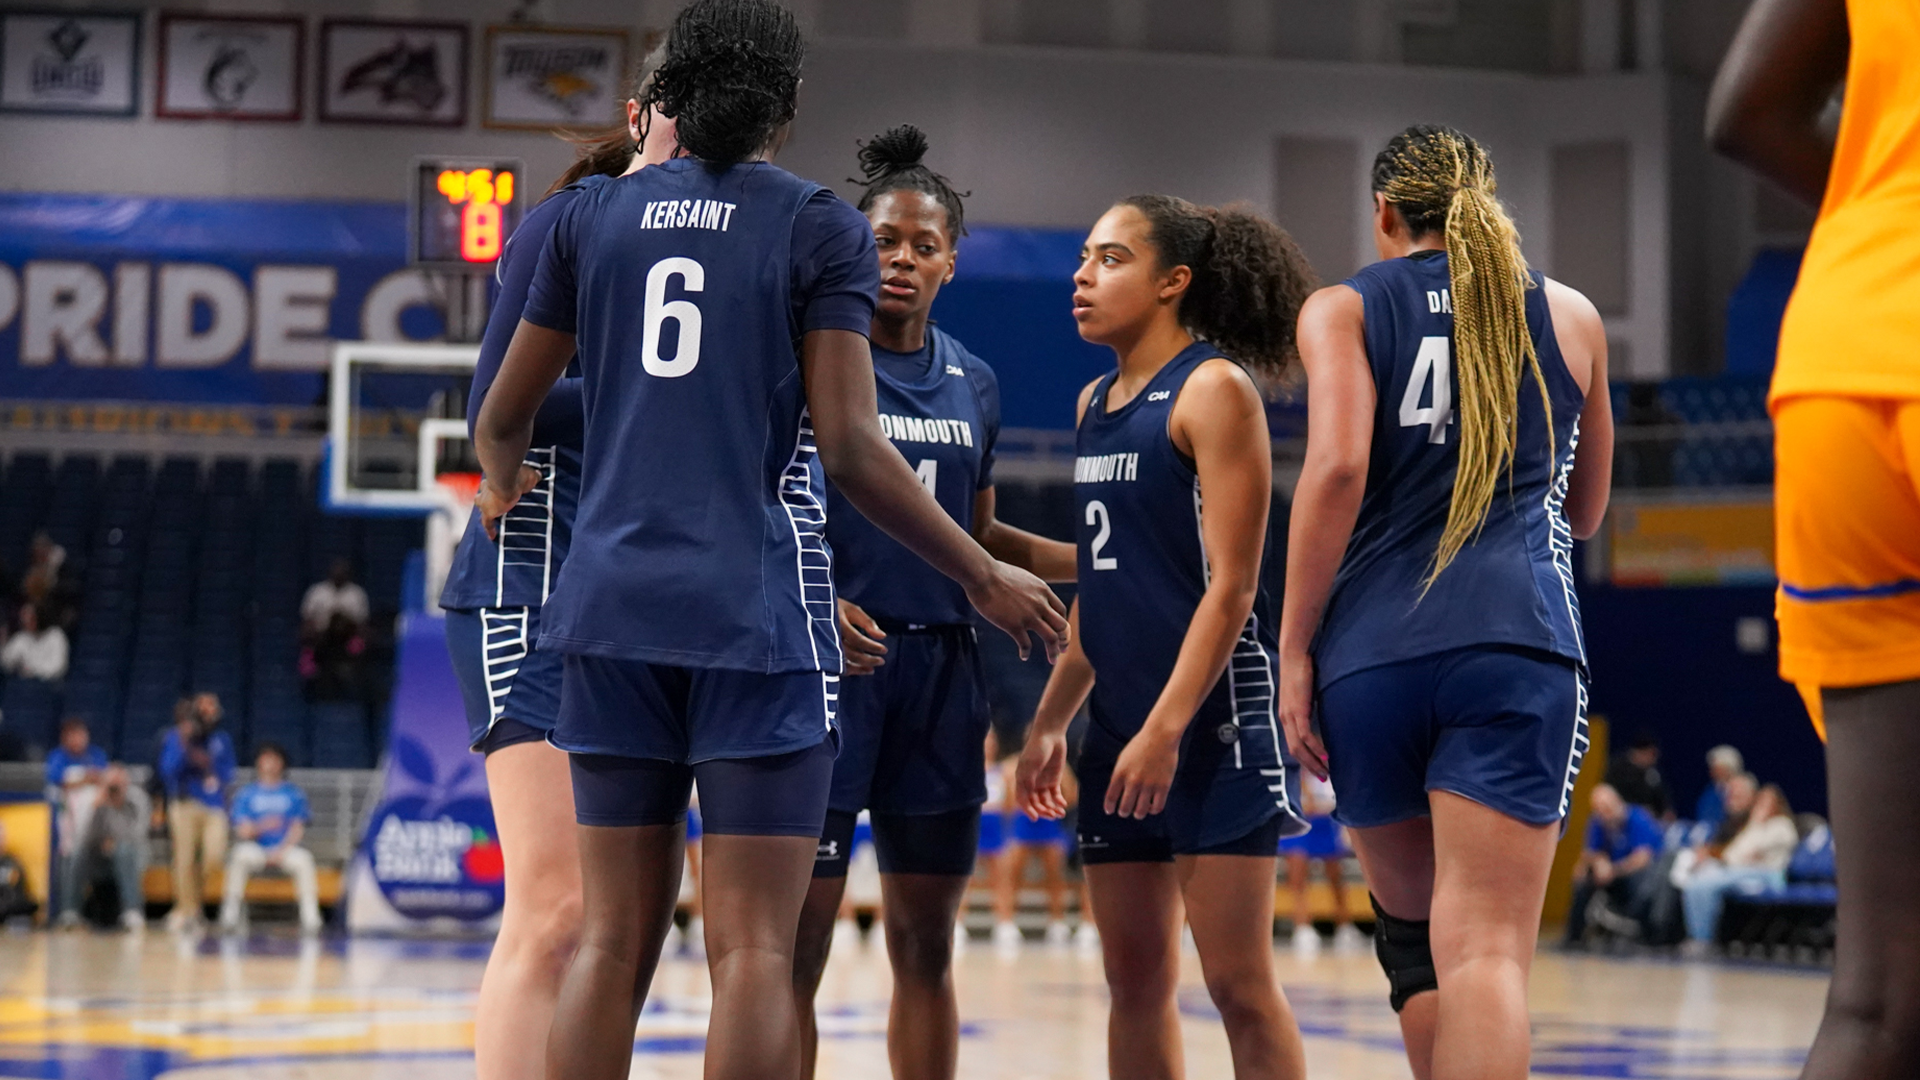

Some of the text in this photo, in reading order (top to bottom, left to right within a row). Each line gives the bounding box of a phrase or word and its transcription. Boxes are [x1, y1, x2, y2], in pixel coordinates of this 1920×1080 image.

[640, 199, 737, 232] KERSAINT
[642, 257, 705, 378] 6
[1147, 390, 1171, 402] CAA
[878, 413, 974, 448] ONMOUTH
[1085, 499, 1118, 571] 2
